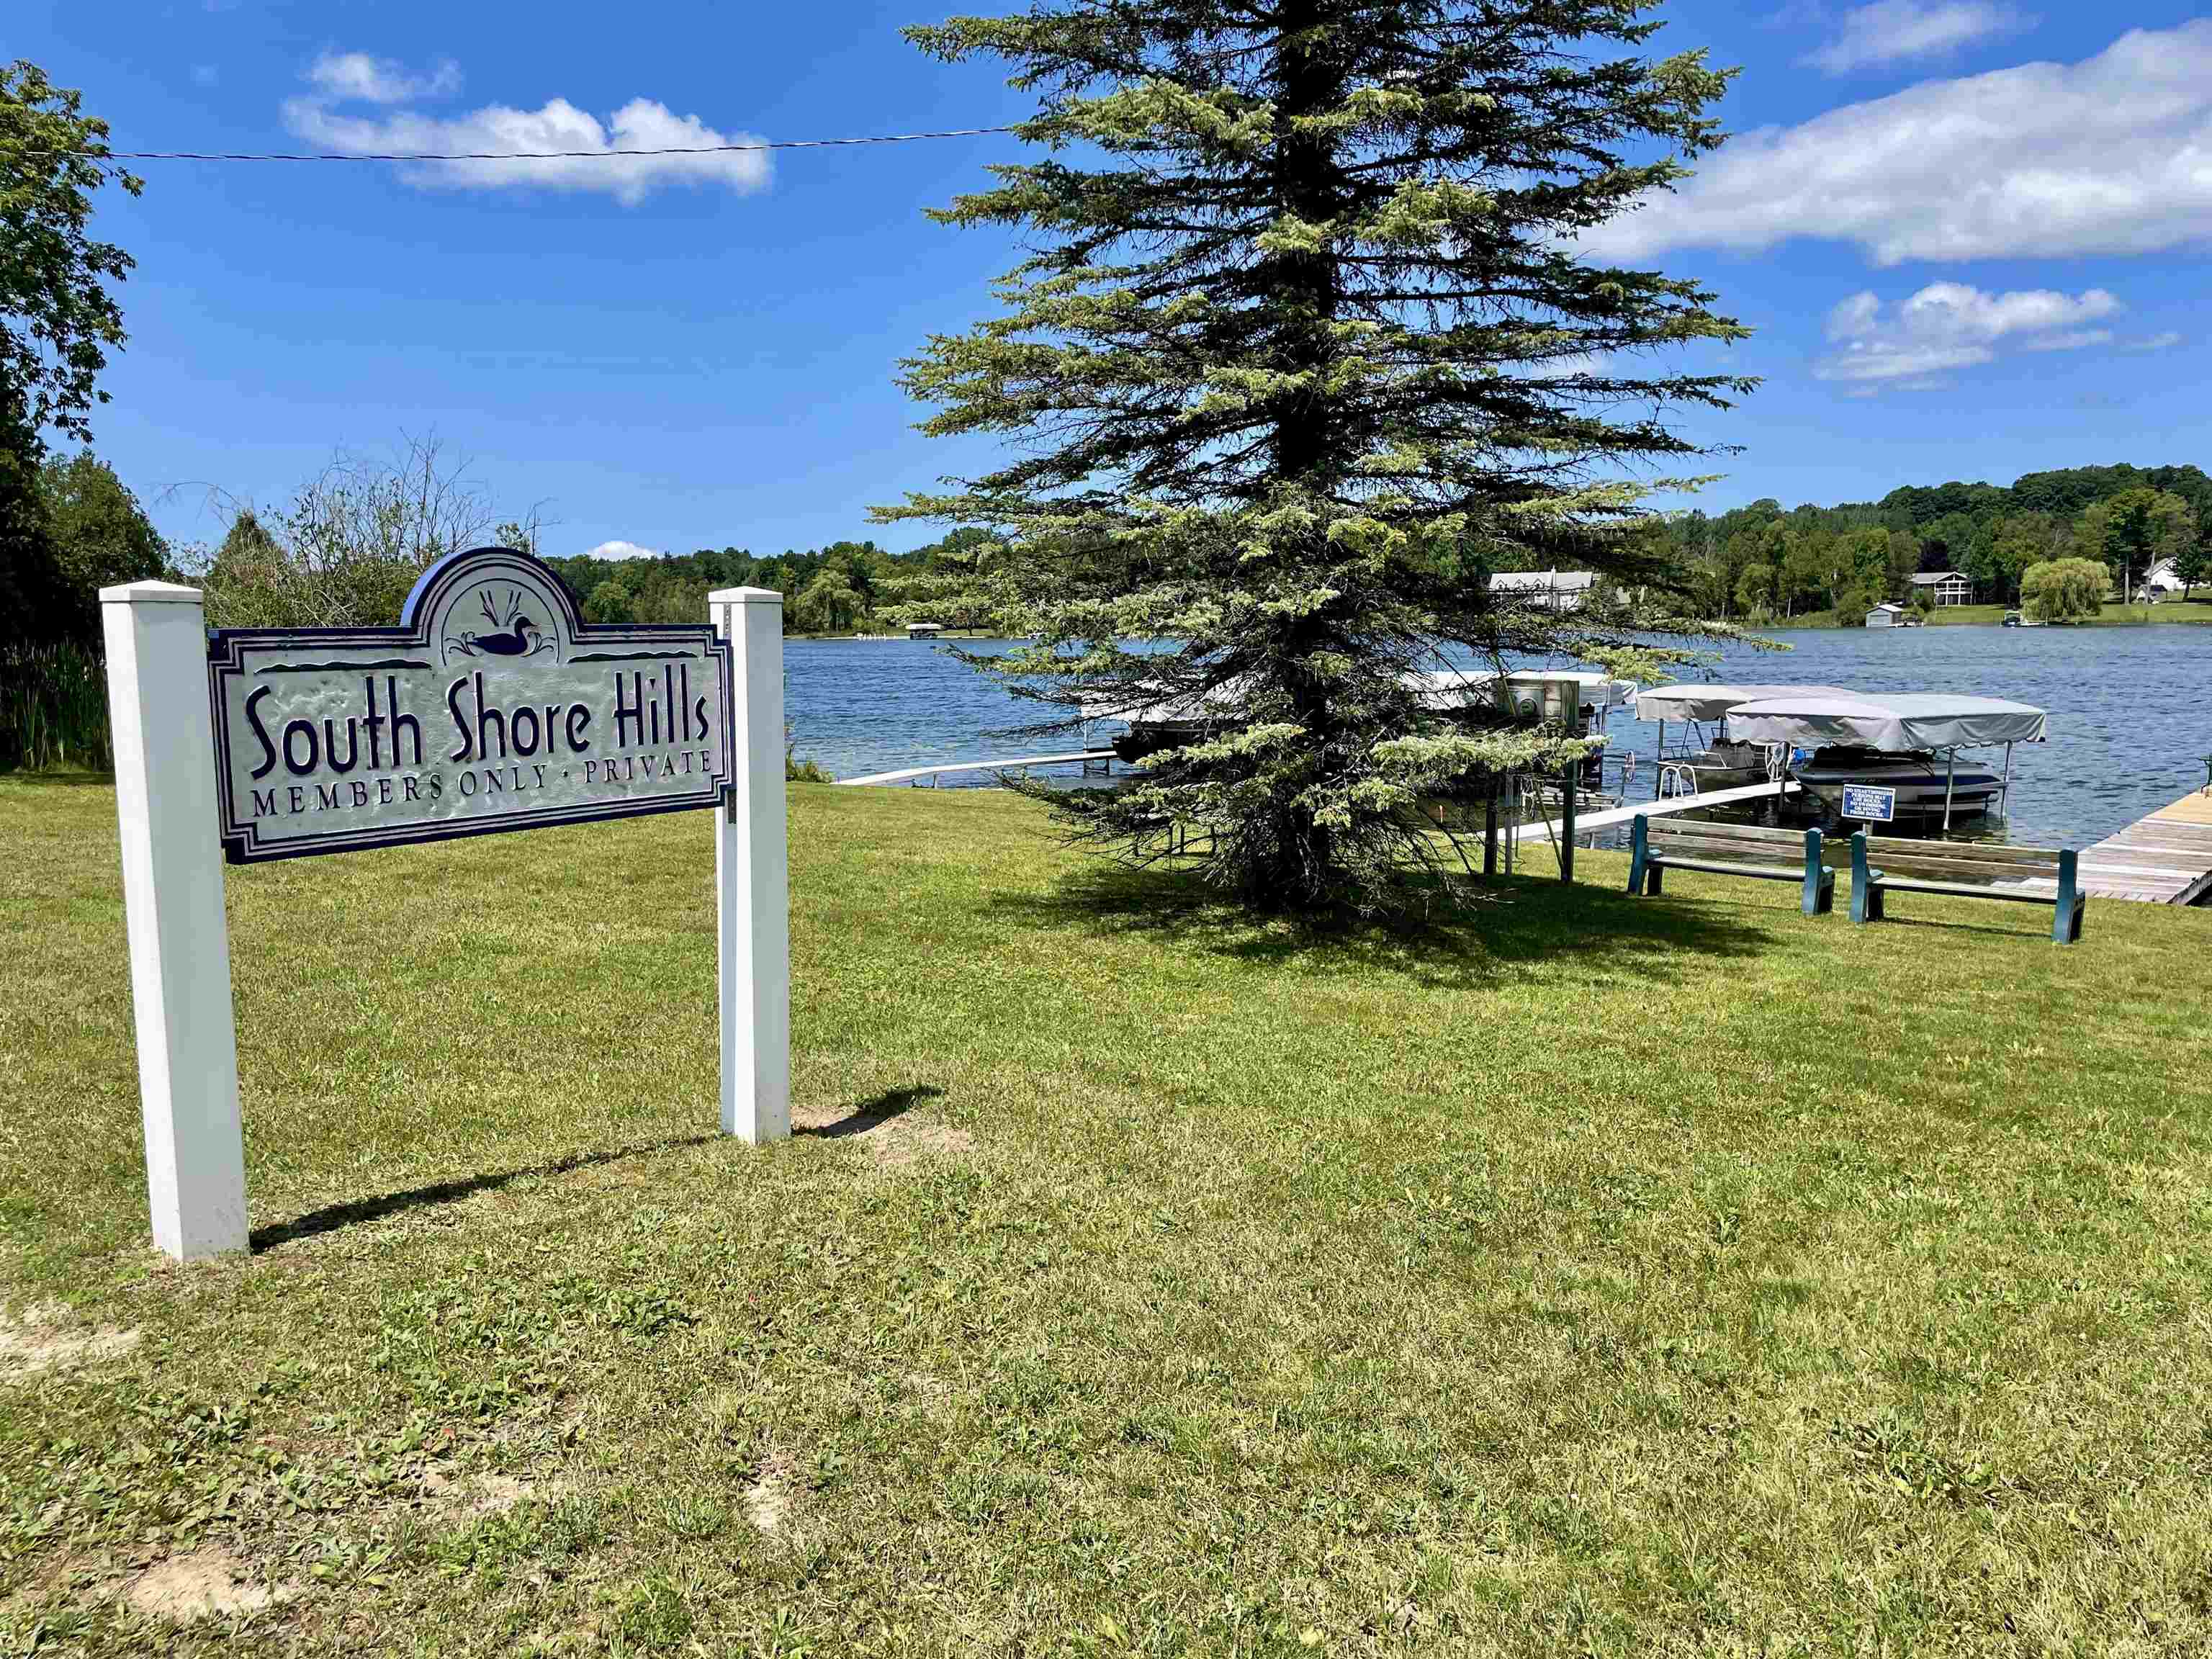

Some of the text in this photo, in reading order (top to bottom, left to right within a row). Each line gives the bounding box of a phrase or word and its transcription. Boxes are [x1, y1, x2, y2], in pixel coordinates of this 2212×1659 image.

[245, 662, 709, 780] South Shore Hills
[251, 750, 712, 818] MEMBERS ONLY PRIVATE
